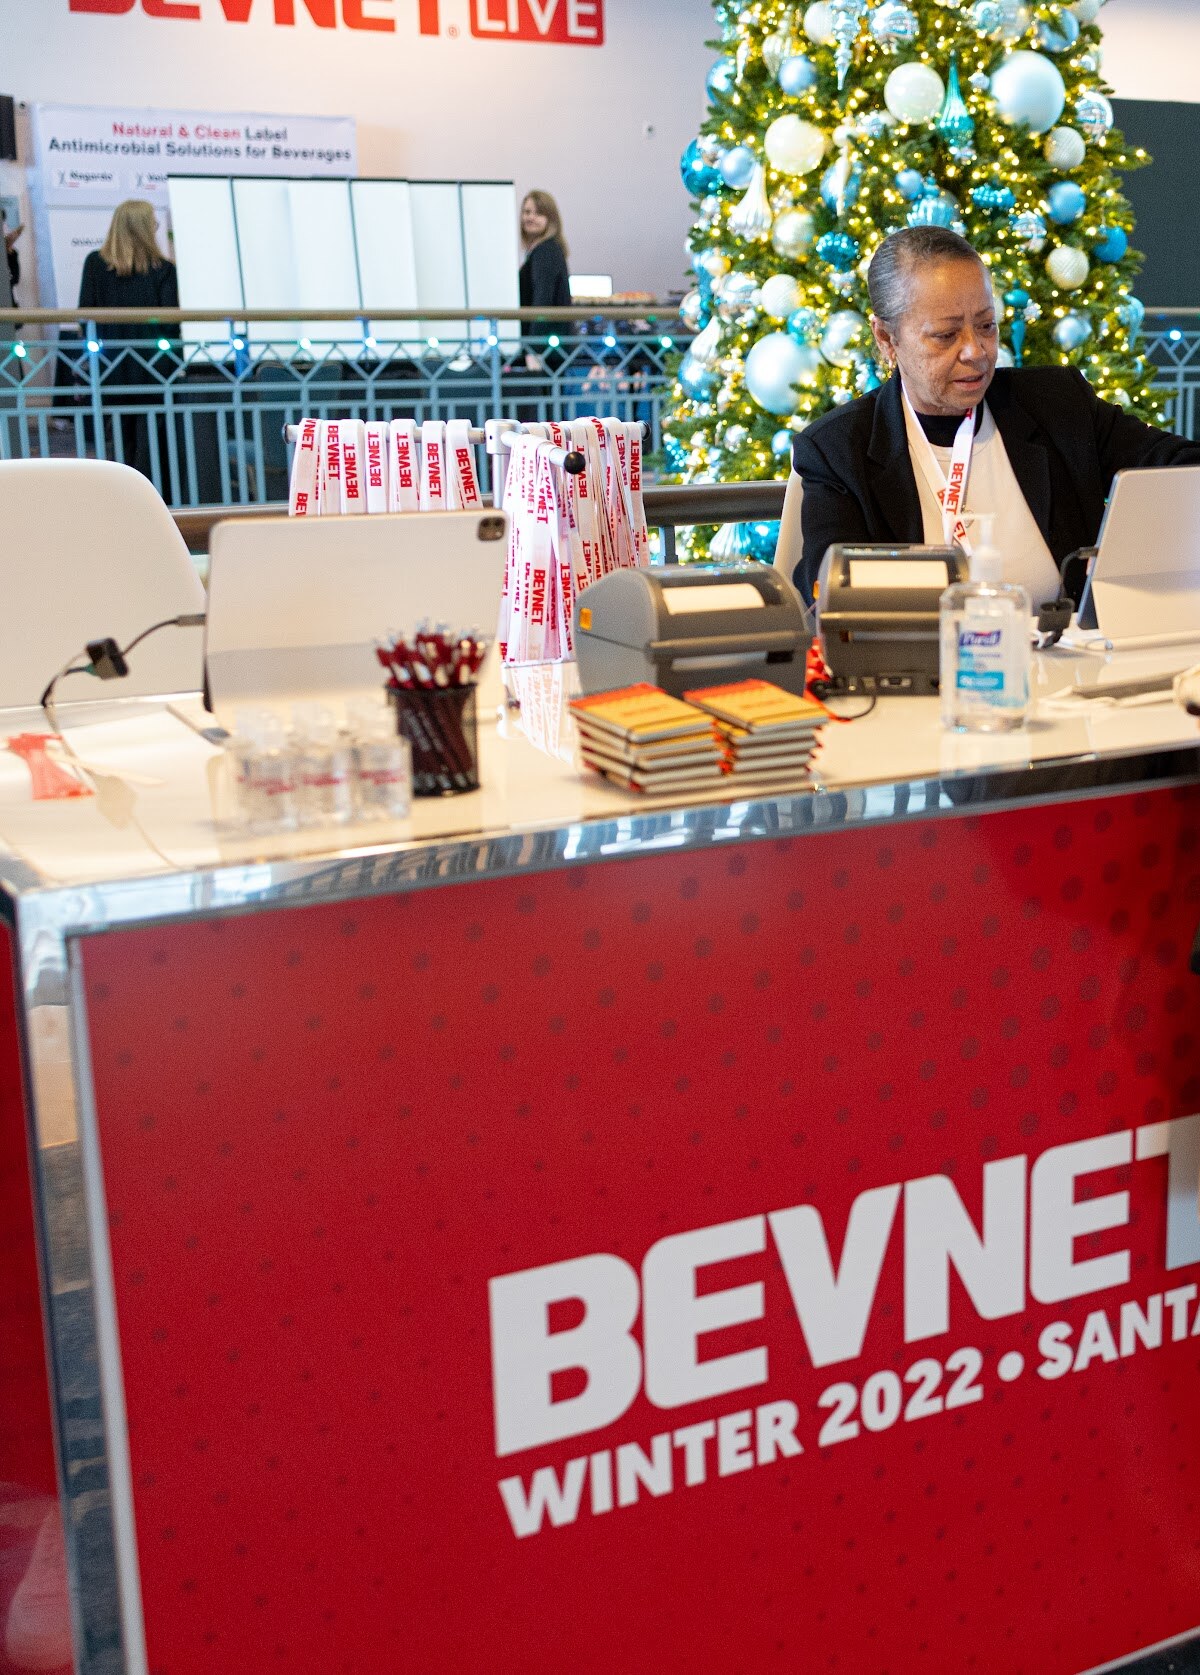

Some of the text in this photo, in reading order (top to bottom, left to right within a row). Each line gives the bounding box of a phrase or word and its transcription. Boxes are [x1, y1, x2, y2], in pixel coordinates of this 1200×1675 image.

[49, 136, 352, 164] Antimicrobial Solutions for Beverages
[112, 122, 288, 141] Natural & Clean Label
[327, 425, 340, 480] BEVNET
[343, 443, 359, 499] BEVNET
[368, 431, 382, 487] BEVNET
[396, 432, 412, 488] BEVNET
[427, 442, 442, 498] BEVNET
[456, 448, 478, 503] BEVNET
[630, 440, 640, 491] BEVNET
[946, 462, 965, 516] BEVNET
[531, 569, 546, 626] BEVNET
[497, 1400, 804, 1541] WINTER
[818, 1347, 984, 1449] 2022
